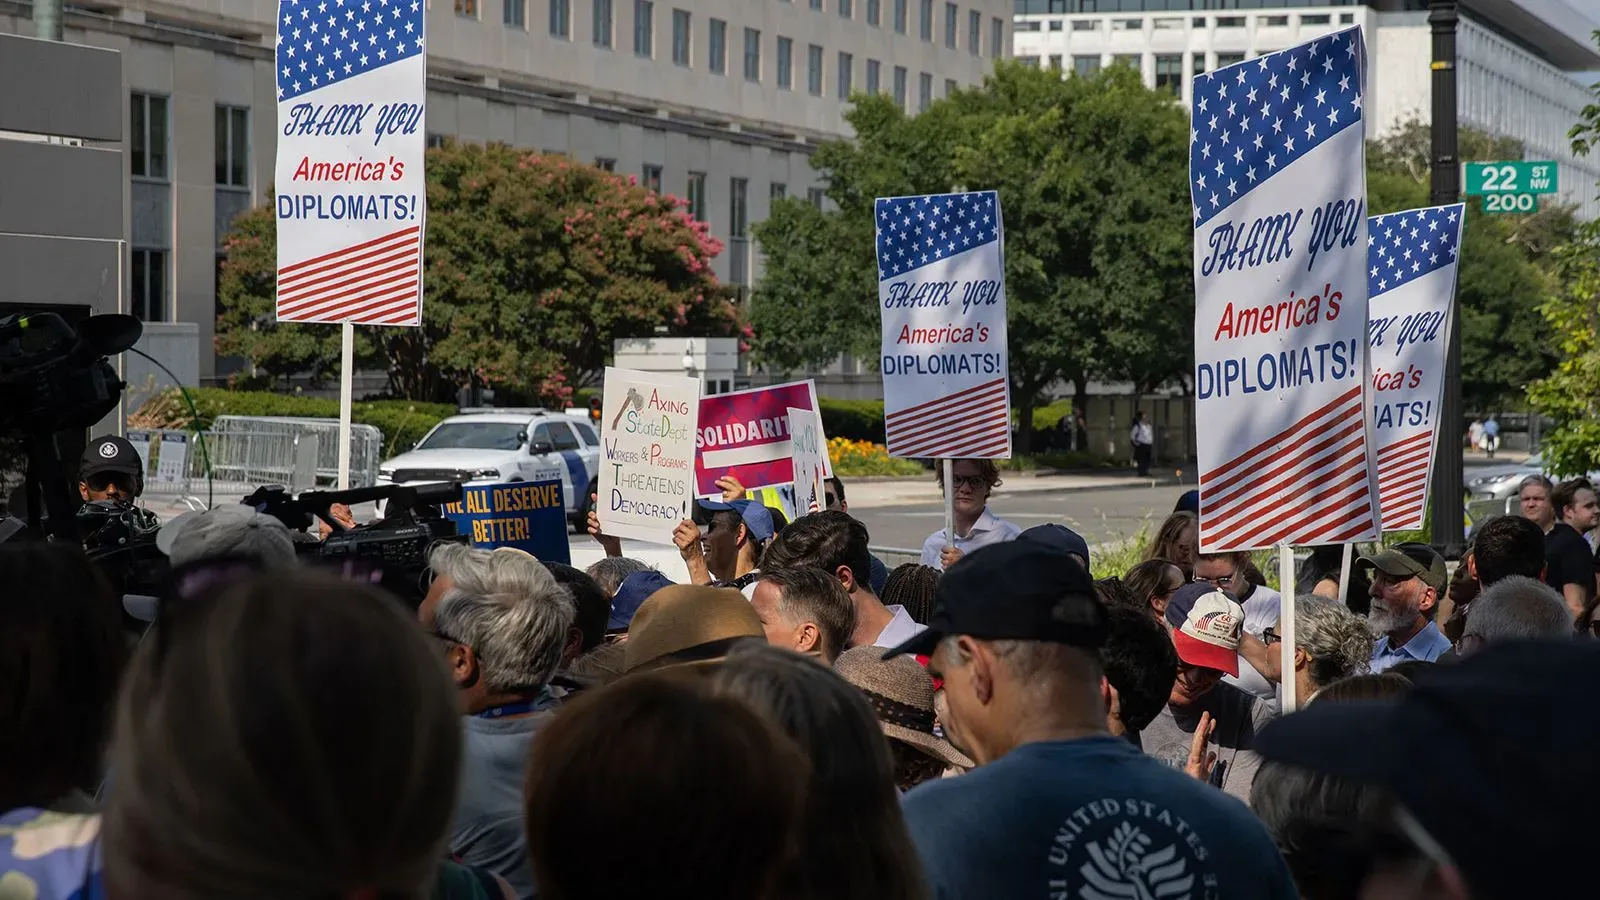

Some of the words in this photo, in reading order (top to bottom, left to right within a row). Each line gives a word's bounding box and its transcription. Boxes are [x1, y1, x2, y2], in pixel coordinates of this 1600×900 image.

[284, 102, 373, 136] THANK
[374, 103, 423, 146] YOU
[293, 156, 404, 181] America's
[1481, 165, 1518, 191] 22
[1531, 166, 1549, 178] ST
[1530, 178, 1550, 189] NW
[278, 194, 416, 220] DIPLOMATS!
[1486, 194, 1533, 211] 200
[1202, 208, 1303, 277] THANK
[1308, 197, 1363, 271] YOU
[884, 281, 958, 308] THANK
[963, 280, 1001, 314] YOU
[1214, 283, 1343, 342] America's
[897, 322, 989, 344] America's
[1395, 310, 1446, 356] YOU
[883, 353, 1000, 375] DIPLOMATS!
[1197, 338, 1357, 400] DIPLOMATS!
[1372, 364, 1423, 392] ica's
[648, 388, 689, 416] AXING
[697, 417, 790, 448] SOLIDARIT
[641, 446, 648, 462] &
[612, 463, 685, 496] THREATENS
[466, 490, 491, 514] ALL
[494, 484, 561, 513] DESERVE
[611, 488, 686, 521] DEMOCRACY!
[472, 517, 530, 543] BETTER!
[1048, 798, 1120, 866] UNITED
[1125, 798, 1208, 861] STATES
